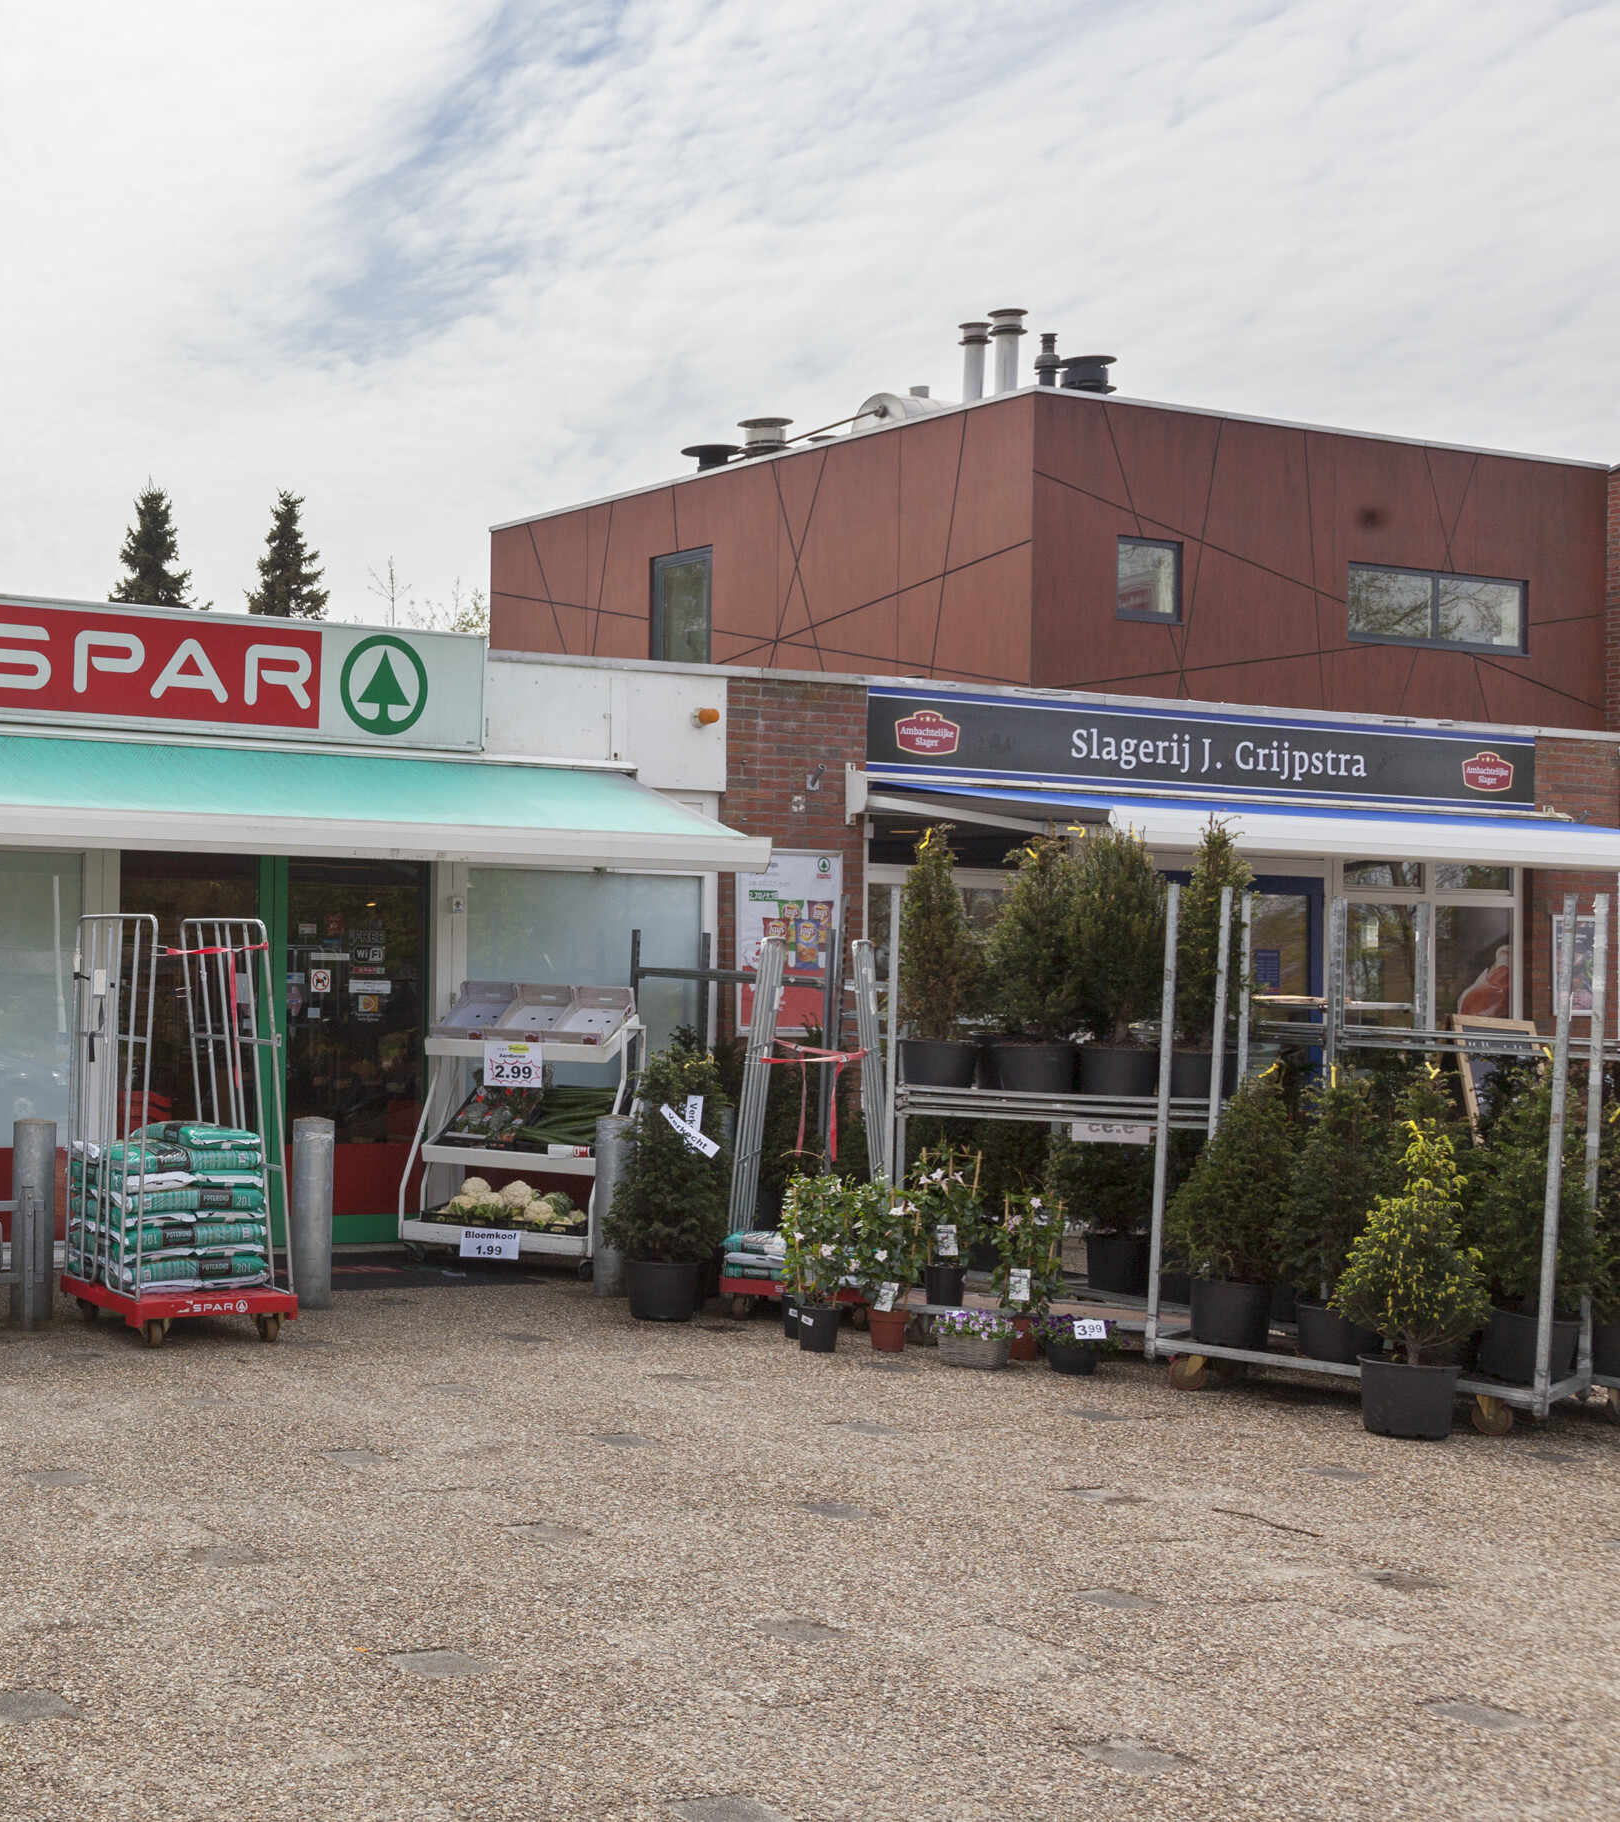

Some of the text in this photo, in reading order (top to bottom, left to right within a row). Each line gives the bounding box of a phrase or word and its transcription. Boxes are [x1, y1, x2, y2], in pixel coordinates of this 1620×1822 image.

[900, 726, 954, 739] Ambachtelijke
[915, 737, 939, 748] Slager
[1071, 729, 1367, 781] Slagerij J. Grijpstra
[1466, 766, 1509, 777] Ambachtelijke
[1478, 775, 1497, 785] Slager
[354, 931, 385, 942] FREE
[495, 1065, 532, 1079] 2.99
[689, 1103, 698, 1128] Verk
[668, 1112, 708, 1150] Verkocht
[203, 1194, 230, 1202] POTGROND
[166, 1230, 193, 1238] POTGROND
[465, 1230, 516, 1240] Bloemkool
[476, 1244, 502, 1256] 1.99
[202, 1263, 229, 1271] POTGROND
[193, 1301, 233, 1313] SPAR
[1077, 1324, 1102, 1337] 3,99
